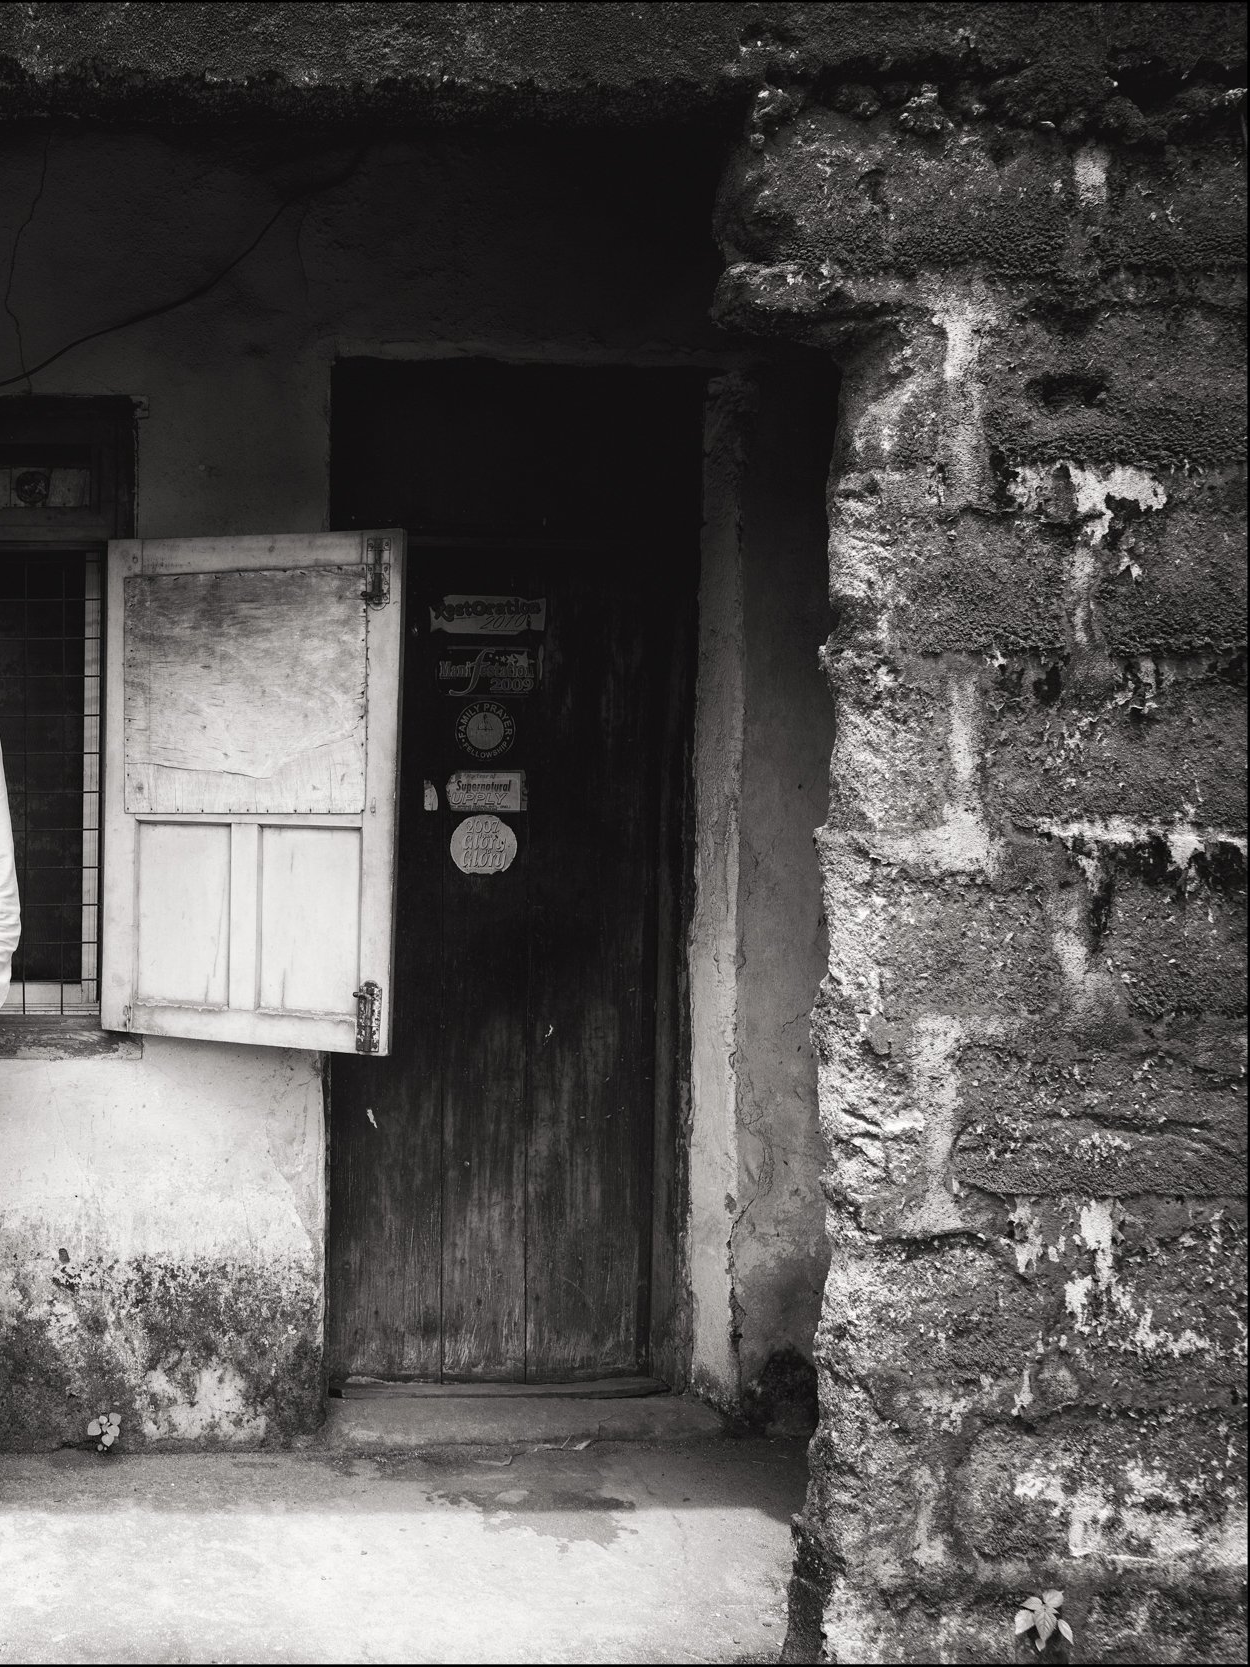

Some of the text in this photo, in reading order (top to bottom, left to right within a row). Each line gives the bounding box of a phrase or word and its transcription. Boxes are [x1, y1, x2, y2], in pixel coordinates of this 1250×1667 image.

[479, 614, 527, 630] 2010
[439, 648, 534, 696] Manifestation
[490, 679, 534, 692] 2009
[458, 703, 513, 738] FAMILY PRAYER
[462, 741, 508, 758] FELLOWSHIP
[456, 780, 512, 793] Supernatural
[450, 792, 508, 805] UPPLY
[462, 851, 507, 871] Glory
